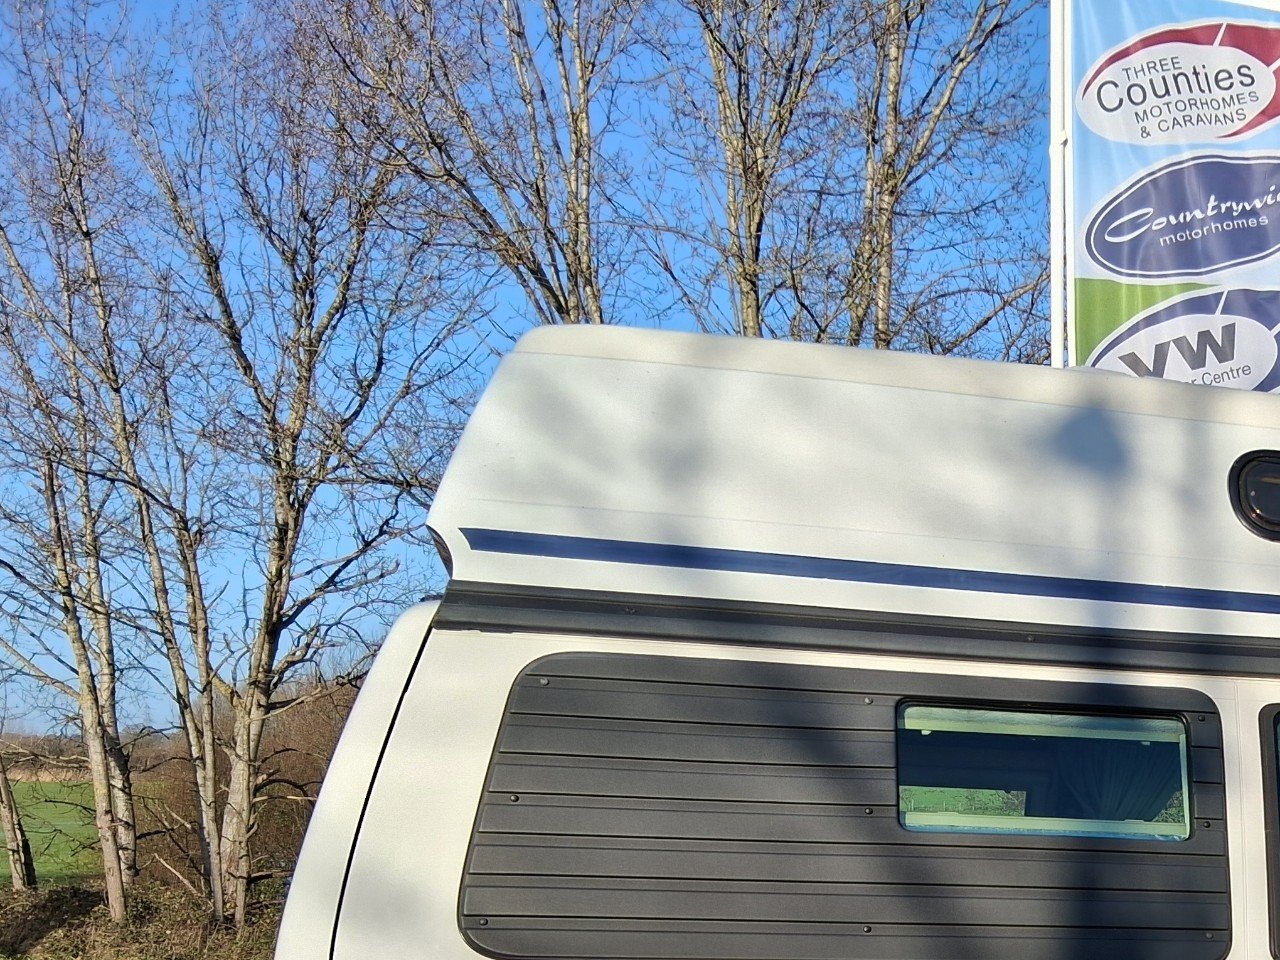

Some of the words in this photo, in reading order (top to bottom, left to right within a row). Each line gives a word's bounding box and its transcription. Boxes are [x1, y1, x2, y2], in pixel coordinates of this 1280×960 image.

[1122, 56, 1183, 82] THREE
[1096, 63, 1256, 113] Counties
[1134, 90, 1260, 124] MOTORHOMES
[1140, 126, 1151, 139] &
[1157, 108, 1248, 133] CARAVANS
[1160, 215, 1269, 247] motorhomes
[1117, 322, 1236, 378] VW
[1201, 364, 1252, 386] Centre
